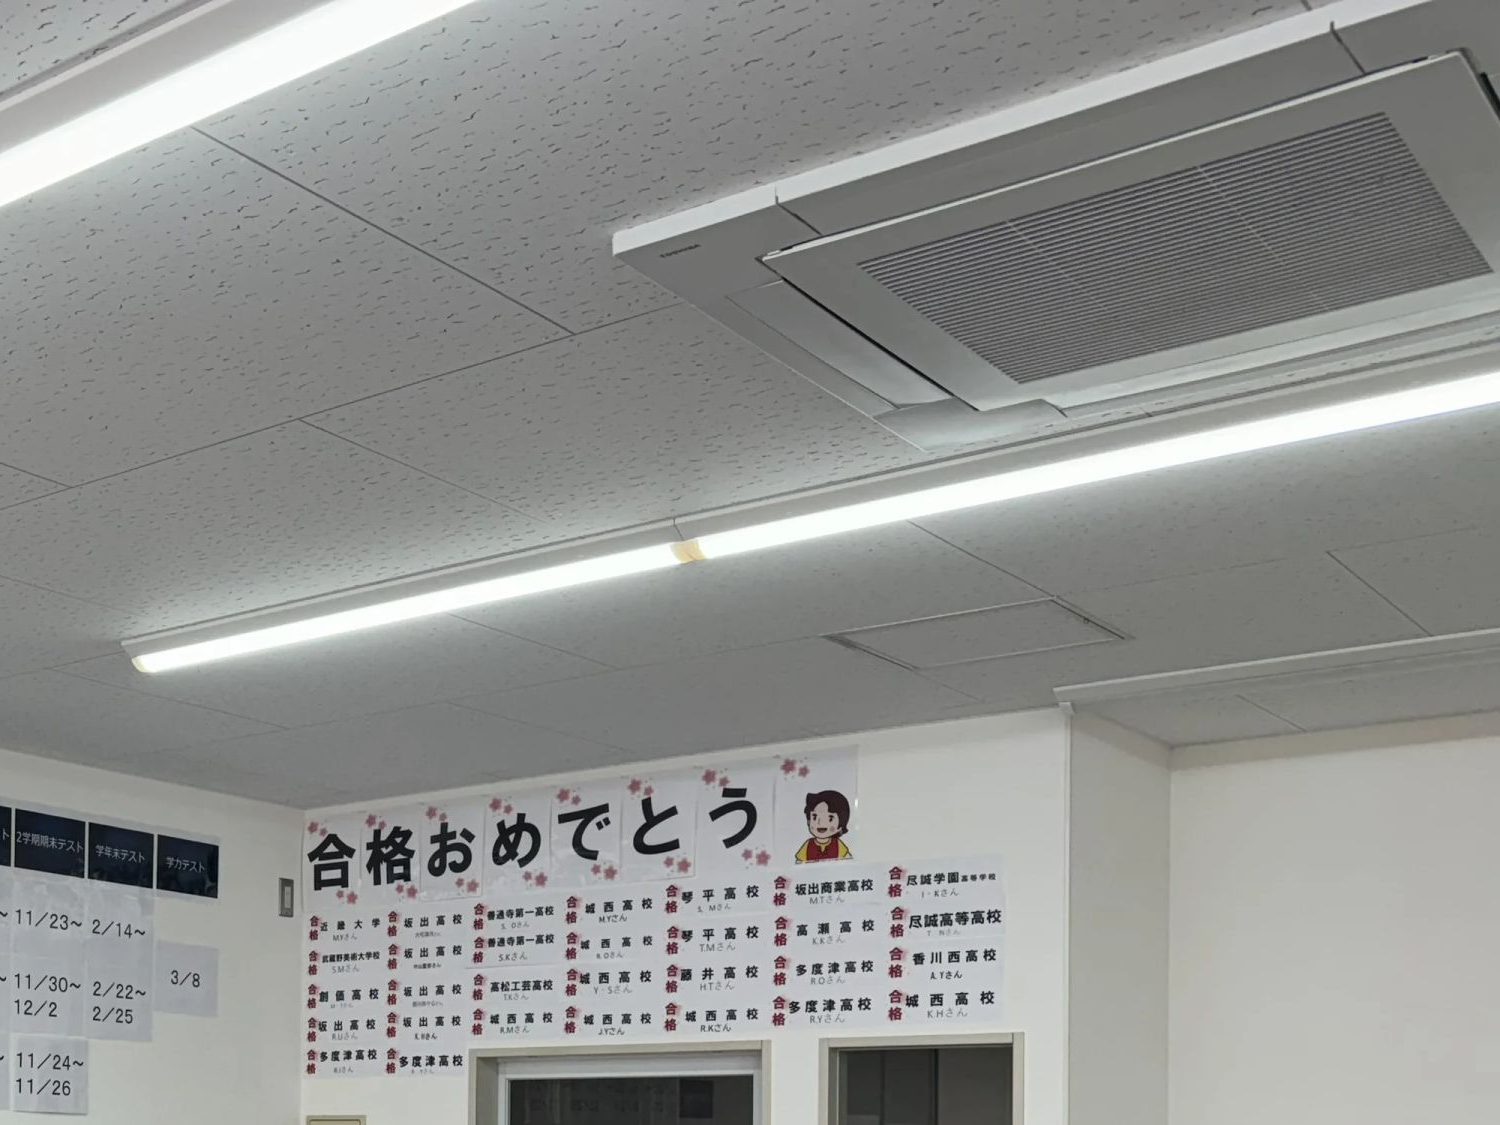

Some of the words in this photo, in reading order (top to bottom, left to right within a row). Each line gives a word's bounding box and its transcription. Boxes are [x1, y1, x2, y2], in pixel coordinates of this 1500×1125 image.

[16, 831, 84, 853] 2学期期末テスト
[307, 787, 758, 891] 合格おめでとう
[95, 844, 145, 863] 学年末テスト
[166, 856, 206, 873] 学力テスト
[796, 879, 874, 896] 坂出商業高校
[888, 866, 903, 898] 合格
[906, 872, 996, 886] 尽誠学園高等学校
[665, 884, 678, 914] 合格
[682, 885, 759, 904] 琴平高校
[773, 876, 788, 907] 合格
[487, 906, 555, 921] 善通寺第一高校
[566, 896, 577, 924] 合格
[585, 898, 653, 914] 城西高校
[320, 918, 380, 932] 近畿大学
[387, 911, 398, 937] 合格
[404, 914, 463, 928] 坂出高校
[473, 903, 485, 931] 合格
[890, 907, 904, 938] 合格
[909, 909, 1002, 929] 尽誠高等高校
[309, 915, 319, 941] 合格
[682, 926, 759, 943] 琴平高校
[774, 917, 788, 947] 合格
[797, 920, 875, 937] 高瀬高校
[473, 936, 485, 964] 合格
[487, 934, 555, 948] 善通寺第一高校
[565, 932, 577, 960] 合格
[580, 936, 653, 950] 城西高校
[666, 926, 679, 955] 合格
[387, 944, 398, 970] 合格
[404, 945, 462, 959] 坂出高校
[913, 949, 997, 965] 香川西高校
[308, 950, 318, 976] 合格
[773, 955, 787, 986] 合格
[796, 960, 874, 977] 多度津高校
[889, 947, 903, 978] 合格
[171, 970, 201, 988] 3/8
[566, 968, 577, 996] 合格
[579, 970, 652, 985] 城西高校
[666, 964, 678, 993] 合格
[680, 965, 759, 981] 藤井高校
[319, 988, 379, 1003] 創価高校
[387, 979, 398, 1006] 合格
[404, 984, 462, 997] 坂出高校
[473, 974, 485, 1001] 合格
[490, 980, 553, 993] 高松工芸高校
[307, 984, 317, 1009] 合格
[789, 997, 872, 1014] 多度津高校
[888, 989, 903, 1021] 合格
[905, 991, 995, 1009] 城西高校
[14, 999, 58, 1018] 12/2
[93, 1006, 134, 1025] 2/25
[665, 1002, 678, 1032] 合格
[685, 1008, 759, 1023] 城西高校
[772, 996, 786, 1027] 合格
[318, 1019, 376, 1032] 坂出高校
[386, 1012, 397, 1038] 合格
[403, 1016, 461, 1028] 坂出高校
[472, 1008, 484, 1036] 合格
[490, 1012, 553, 1025] 城西高校
[565, 1006, 576, 1034] 合格
[584, 1013, 652, 1025] 城西高校
[307, 1017, 317, 1042] 合格
[306, 1049, 317, 1074] 合格
[320, 1049, 377, 1062] 多度津高校
[386, 1048, 397, 1074] 合格
[400, 1055, 464, 1068] 多度津高校
[16, 1078, 71, 1096] 11/26
